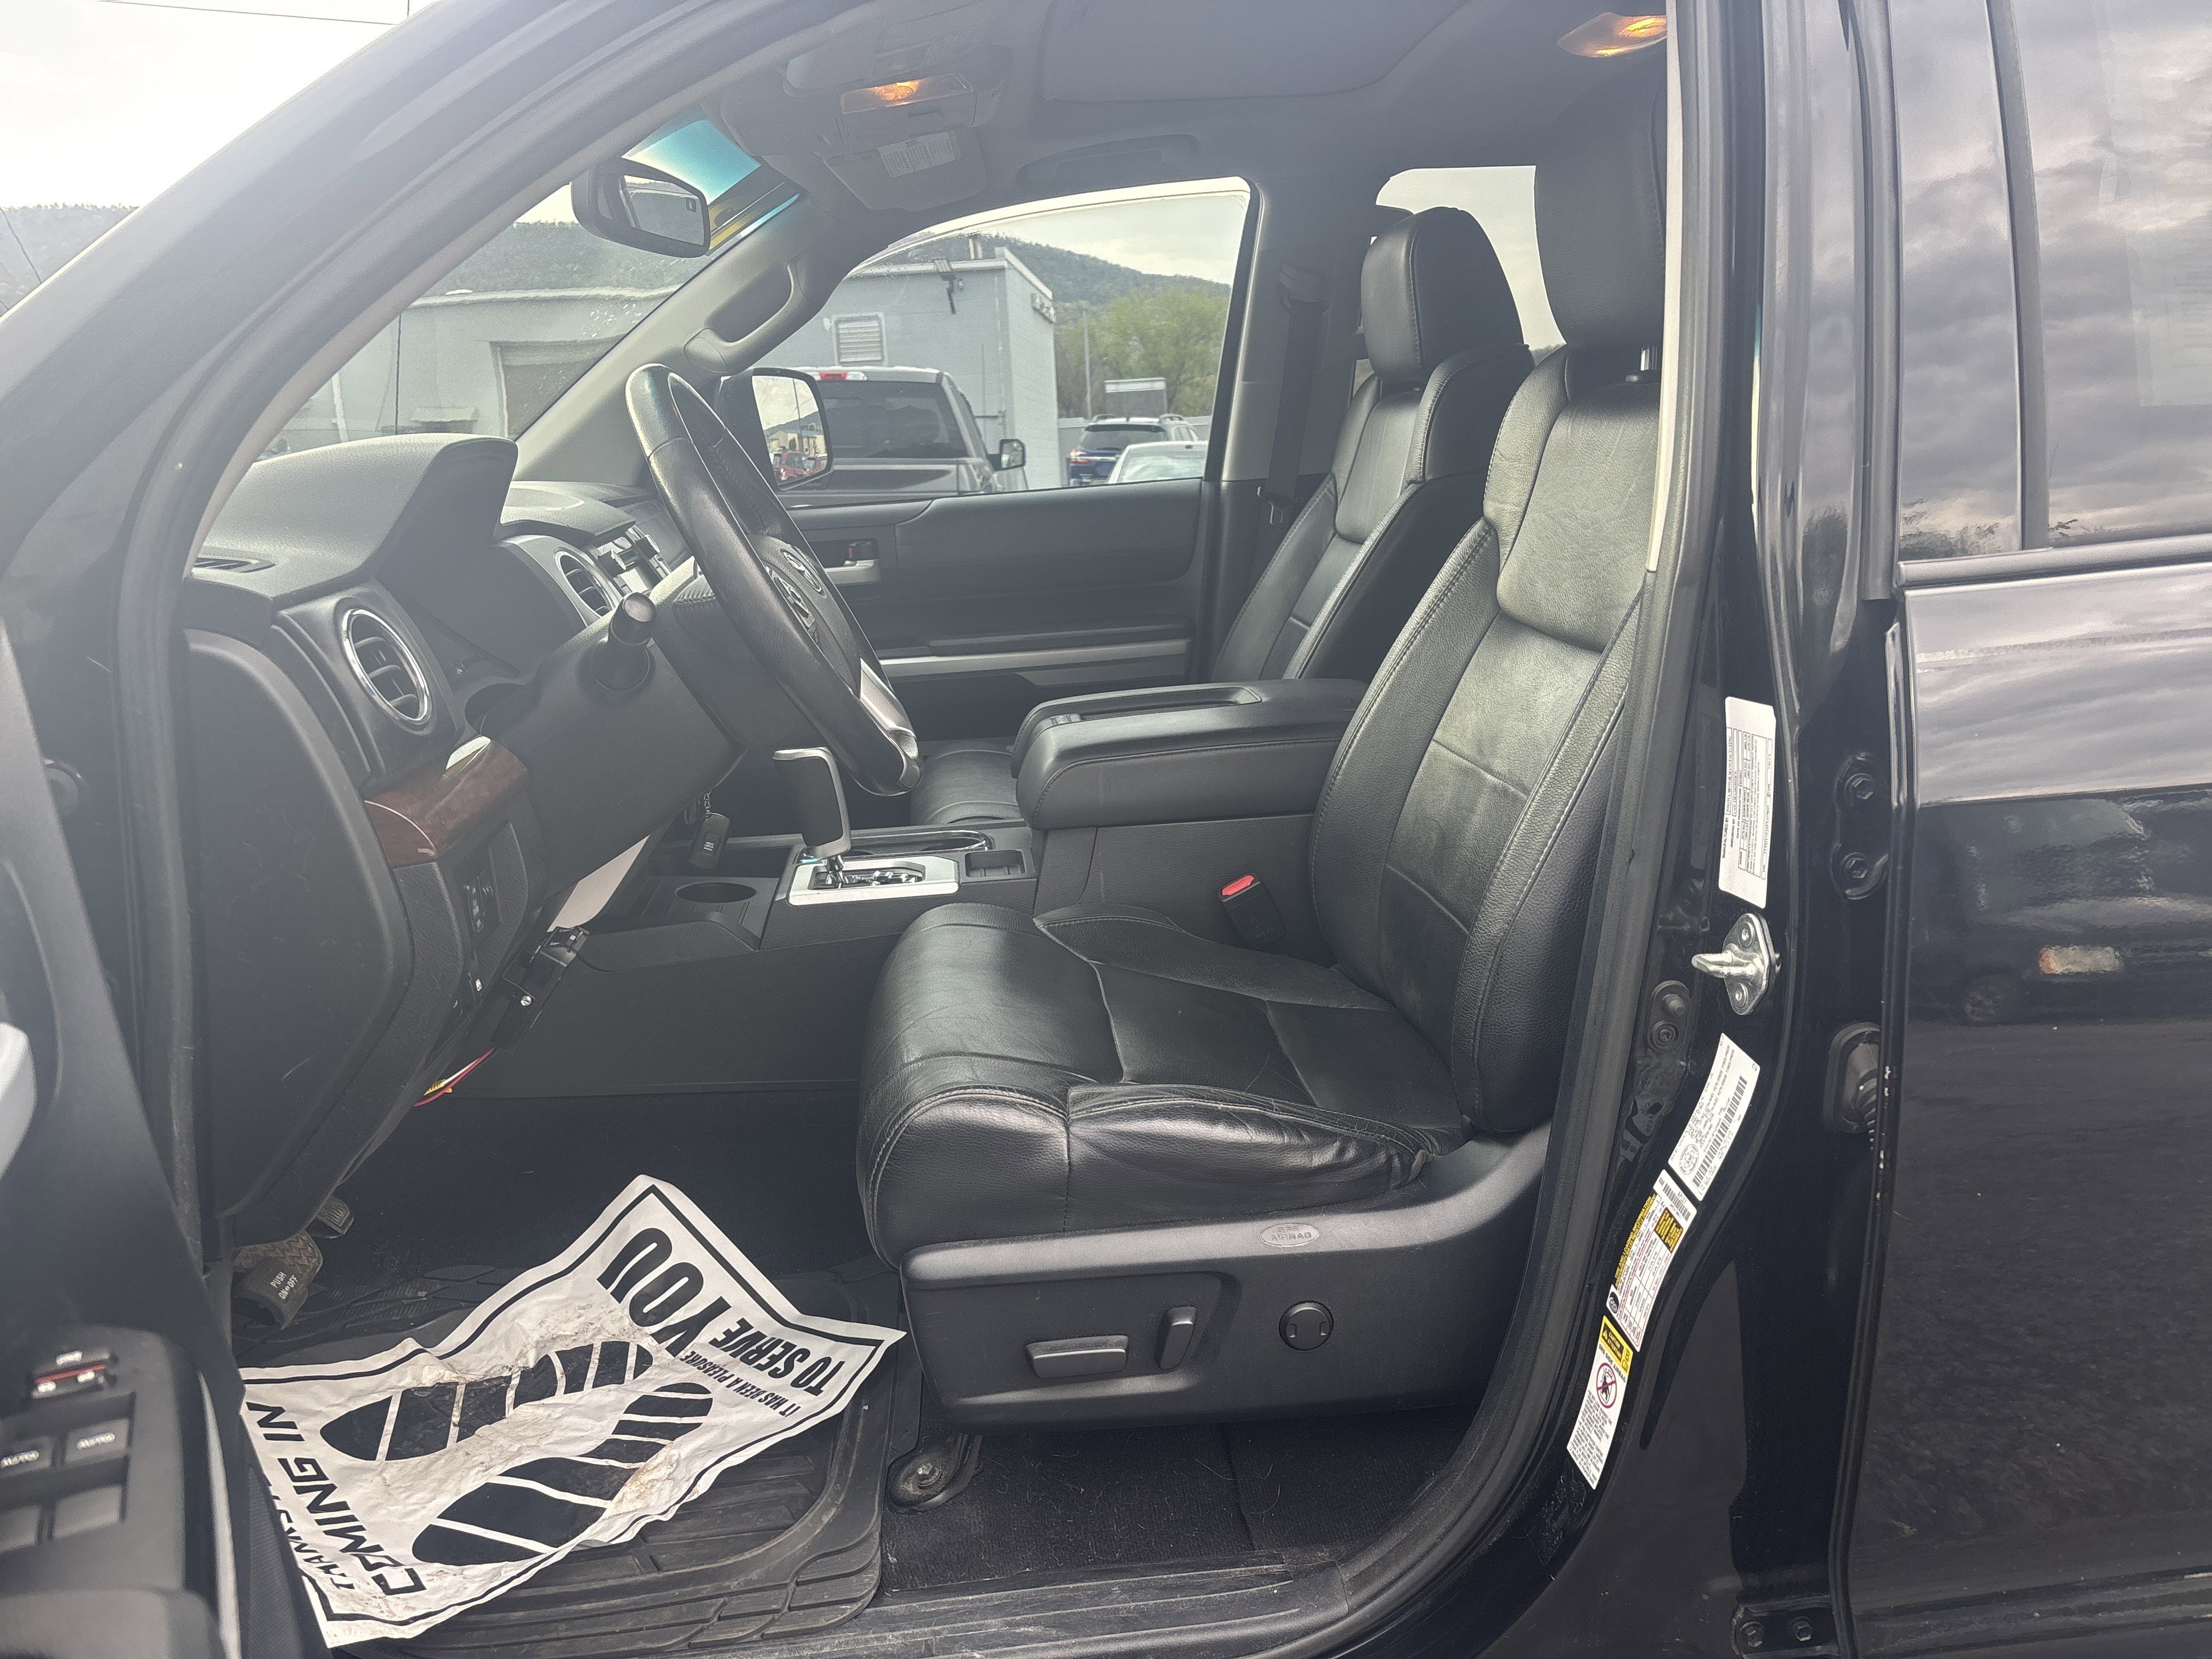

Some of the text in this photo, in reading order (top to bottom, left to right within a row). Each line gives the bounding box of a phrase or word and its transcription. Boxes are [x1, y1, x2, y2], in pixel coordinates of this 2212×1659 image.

[1270, 1232, 1312, 1242] AIRBAG
[270, 1271, 287, 1289] PUSH
[597, 1228, 732, 1358] YOU
[679, 1351, 801, 1417] IT HAS BEEN A PLEASURE
[708, 1318, 845, 1396] TO SERVE
[245, 1402, 427, 1595] COMING IN
